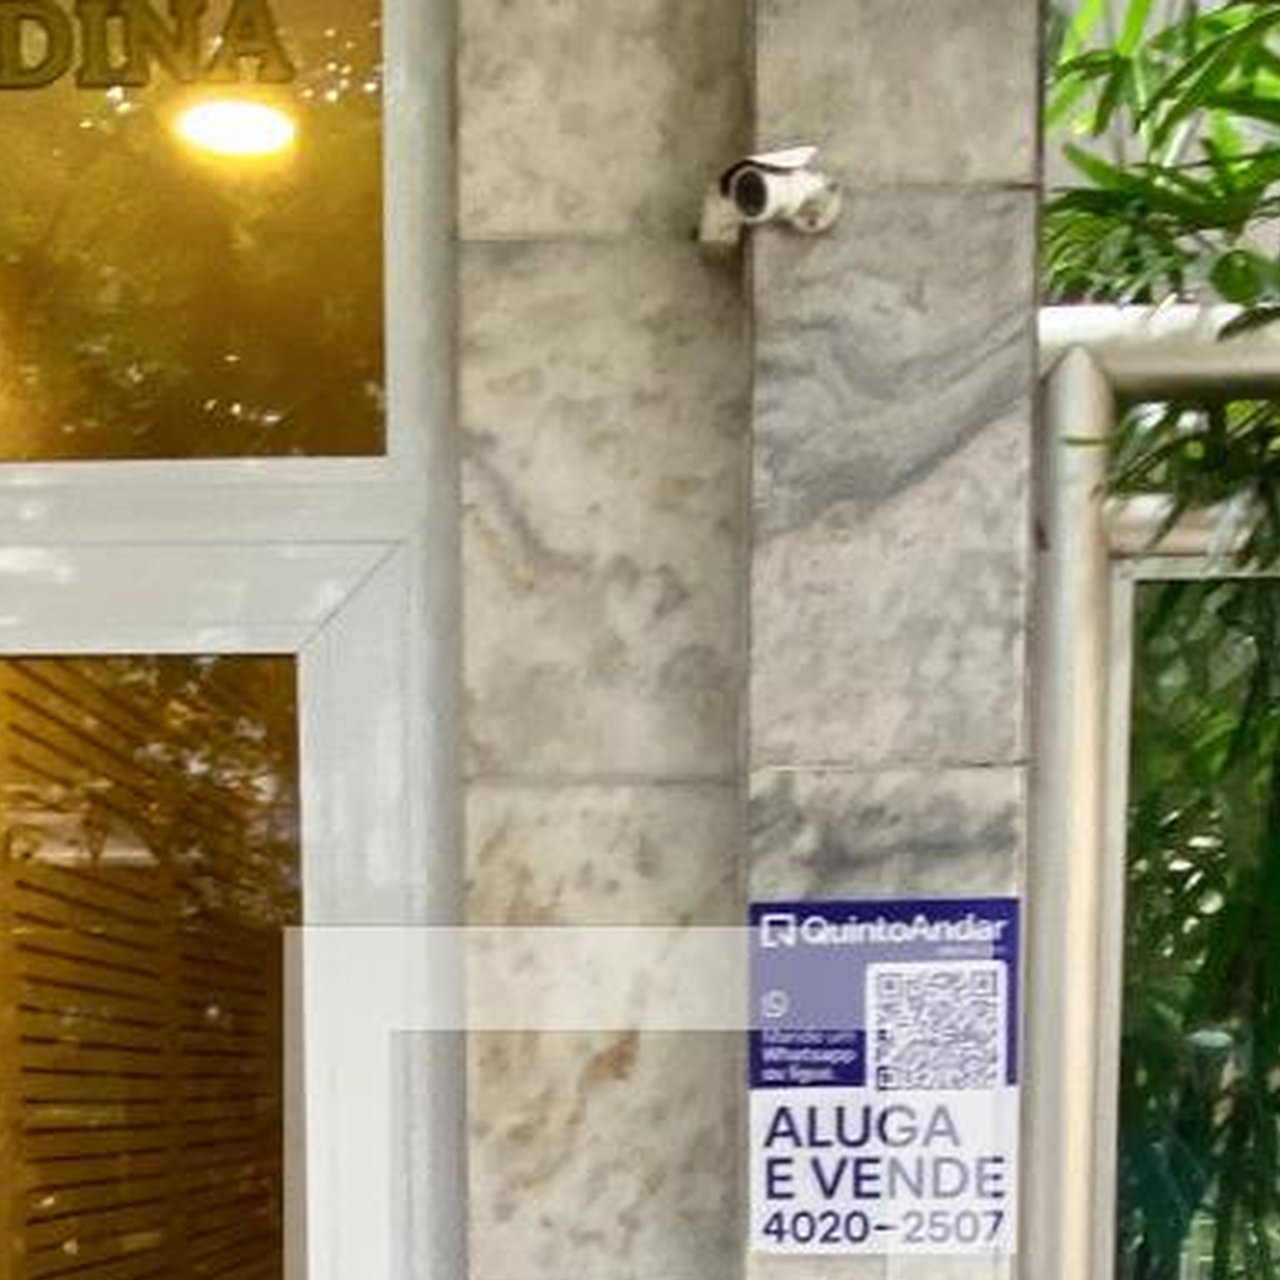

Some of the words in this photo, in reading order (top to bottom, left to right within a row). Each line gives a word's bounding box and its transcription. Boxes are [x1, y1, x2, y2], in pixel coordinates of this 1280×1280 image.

[801, 914, 1009, 943] QuintoAndar
[763, 1105, 962, 1148] ALUGA
[766, 1157, 795, 1200] E
[810, 1157, 1006, 1200] VENDE
[762, 1211, 1005, 1244] 4020-2507
